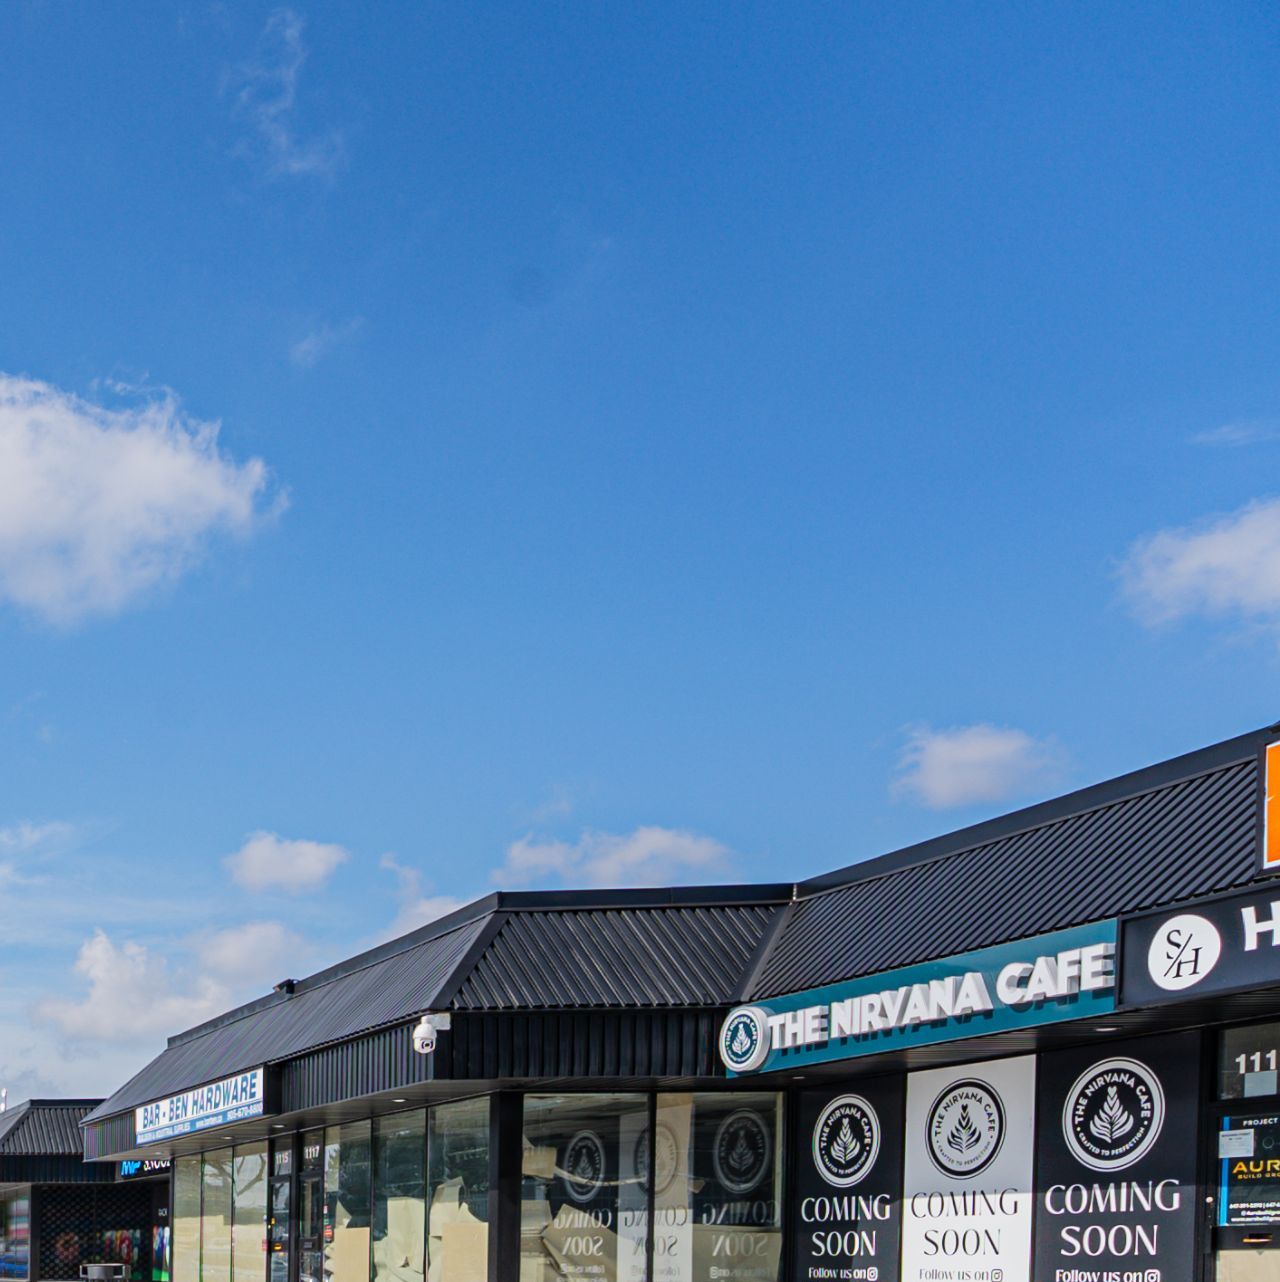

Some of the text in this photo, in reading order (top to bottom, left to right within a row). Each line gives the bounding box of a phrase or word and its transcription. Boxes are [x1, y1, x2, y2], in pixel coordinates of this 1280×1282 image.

[768, 943, 1116, 1050] THE NIRVANA CAFE
[143, 1103, 160, 1129] BAR
[168, 1095, 189, 1122] BEN
[191, 1072, 258, 1115] HARDWARE
[935, 1092, 995, 1137] THE NIRVANA CAFE
[1074, 1072, 1151, 1125] THE NIRVANA CAFE
[820, 1126, 830, 1149] THE
[827, 1106, 862, 1126] NIRVANA
[1242, 1117, 1278, 1126] PROJECT
[304, 1146, 320, 1159] 1117
[801, 1194, 890, 1222] COMING
[911, 1187, 1019, 1219] COMING
[1044, 1179, 1181, 1215] COMING
[811, 1230, 877, 1257] SOON
[923, 1228, 1001, 1256] SOON
[1060, 1224, 1158, 1256] SOON
[808, 1267, 867, 1279] Follow us on
[919, 1268, 990, 1281] Follow us on
